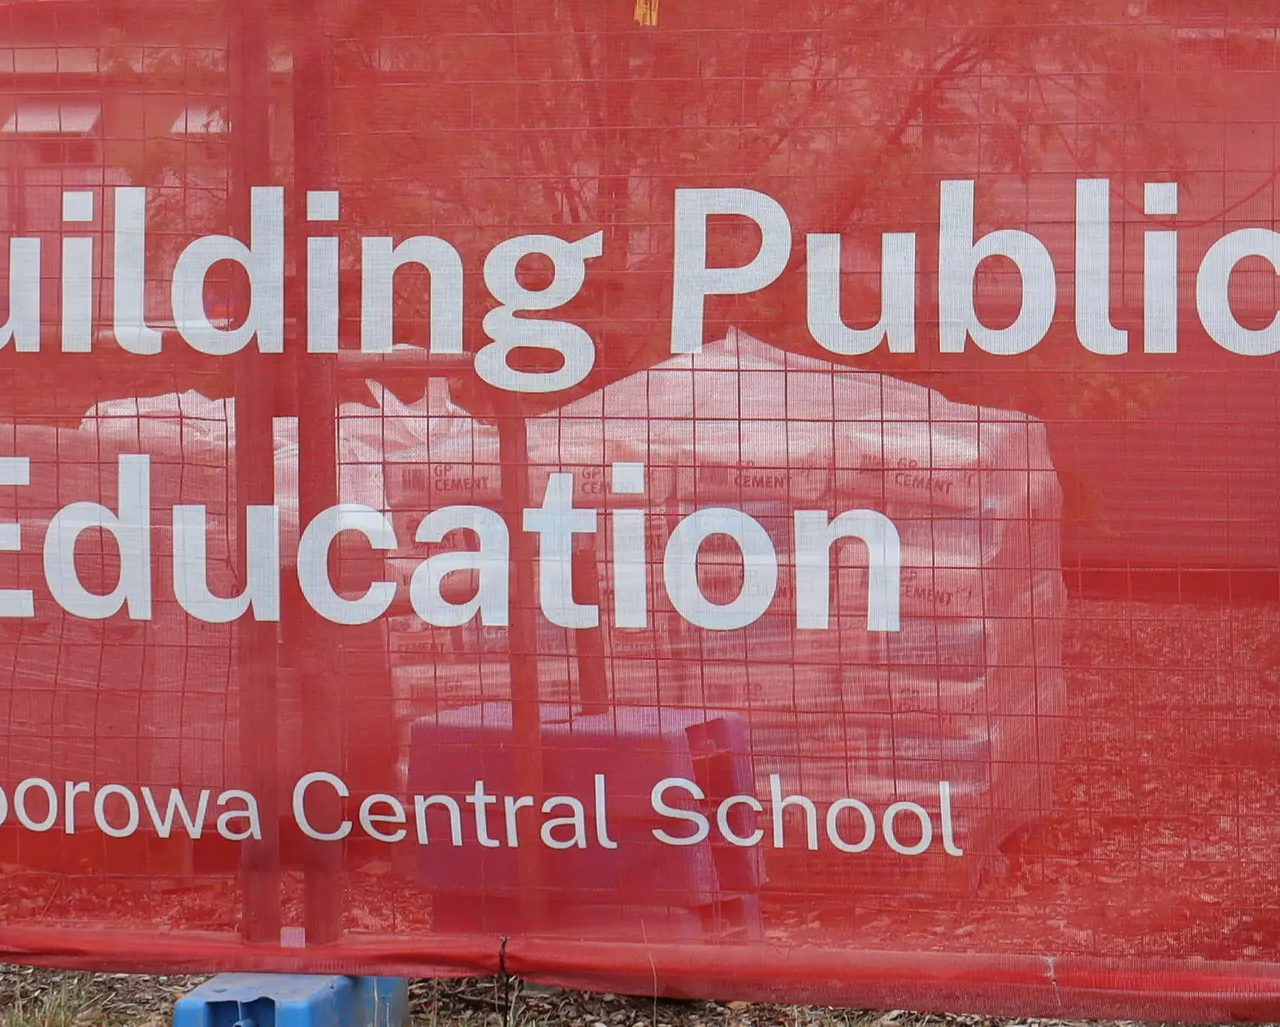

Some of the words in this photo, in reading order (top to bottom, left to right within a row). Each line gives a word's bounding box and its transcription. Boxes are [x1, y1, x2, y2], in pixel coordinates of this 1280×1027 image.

[433, 476, 489, 492] CEMENT
[734, 473, 792, 489] CEMENT
[894, 472, 954, 494] CEMENT
[292, 771, 618, 849] Central
[650, 773, 964, 857] School
